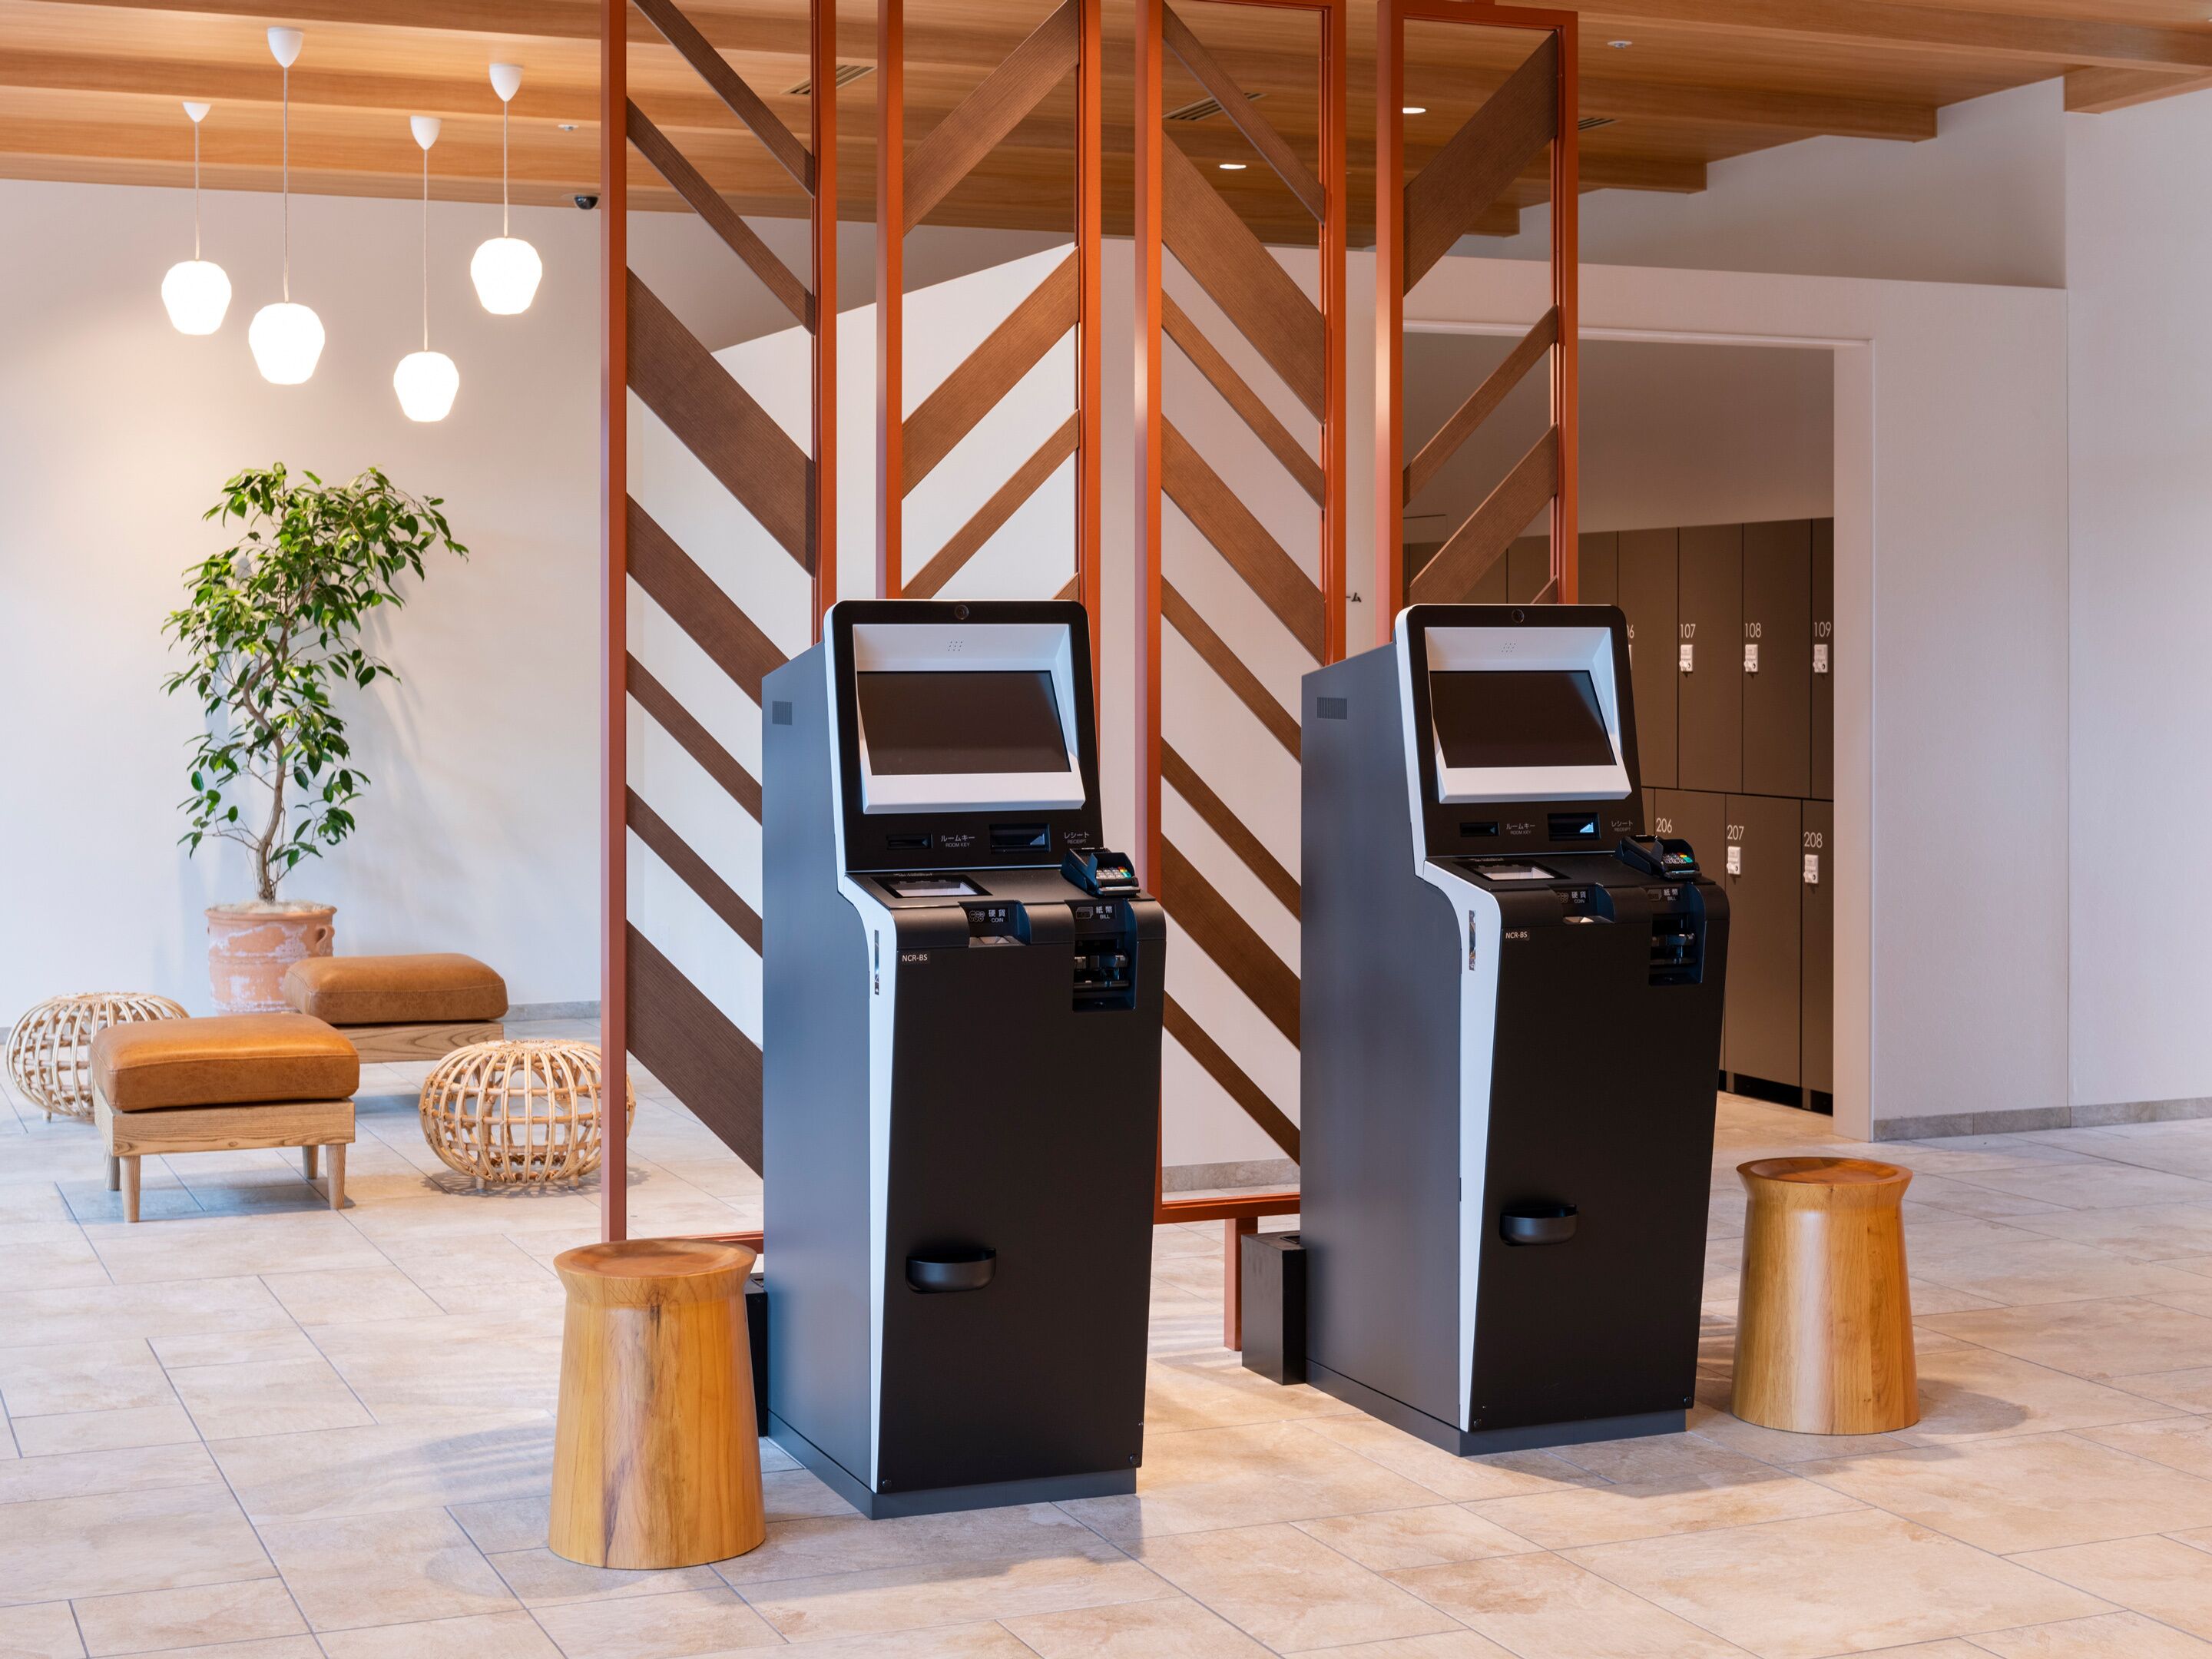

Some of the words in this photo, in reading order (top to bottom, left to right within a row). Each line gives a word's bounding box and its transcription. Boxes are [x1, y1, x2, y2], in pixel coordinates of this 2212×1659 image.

[1680, 623, 1696, 639] 107
[1745, 622, 1762, 638] 108
[1814, 621, 1832, 637] 109
[1656, 817, 1673, 833] 206
[1727, 824, 1744, 840] 207
[1803, 831, 1823, 849] 208
[988, 909, 1006, 918] 硬貨
[1095, 906, 1113, 914] 紙幣
[1505, 931, 1528, 939] NCR-BS
[902, 953, 928, 962] NCR-BS
